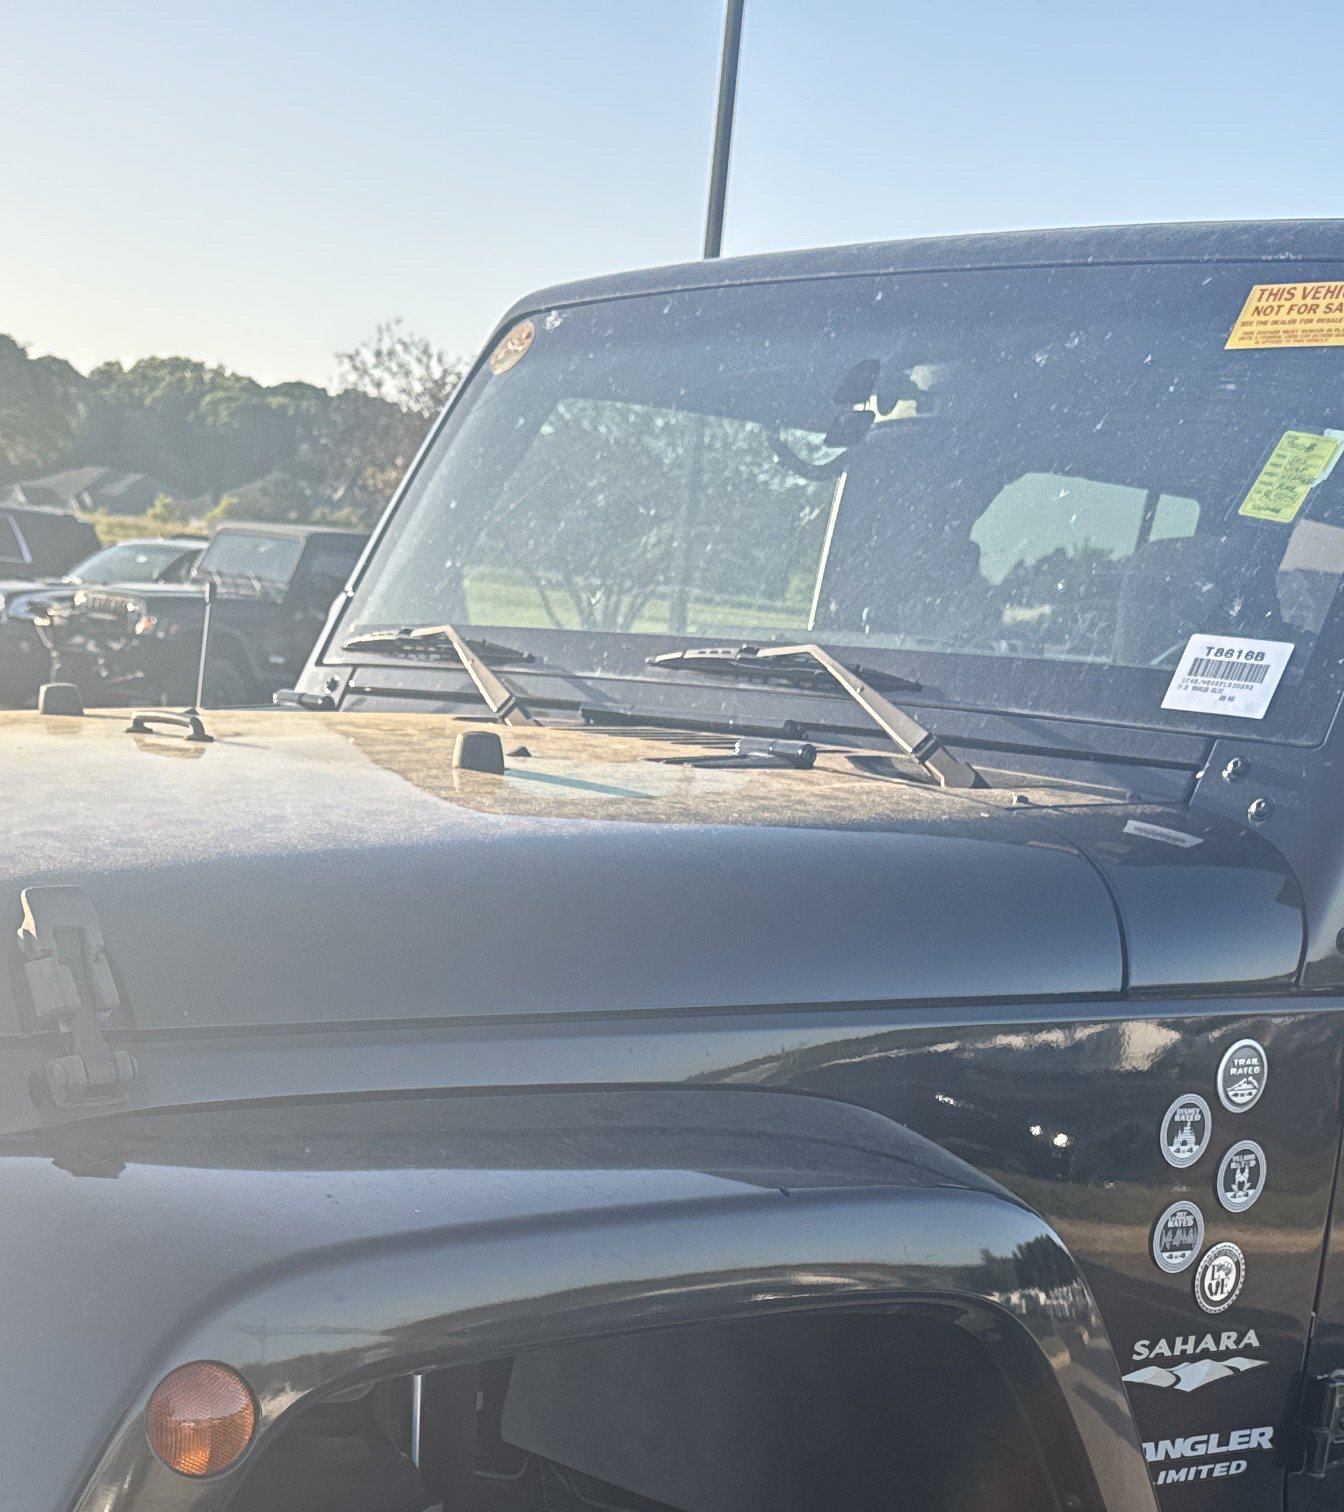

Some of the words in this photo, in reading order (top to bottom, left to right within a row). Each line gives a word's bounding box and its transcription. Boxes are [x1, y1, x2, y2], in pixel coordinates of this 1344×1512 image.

[1257, 286, 1297, 303] THIS
[1251, 304, 1285, 317] NOT
[1286, 303, 1320, 316] FOR
[1233, 1057, 1260, 1066] TRAIL
[1229, 1066, 1261, 1076] RATED
[1131, 1329, 1260, 1361] SAHARA
